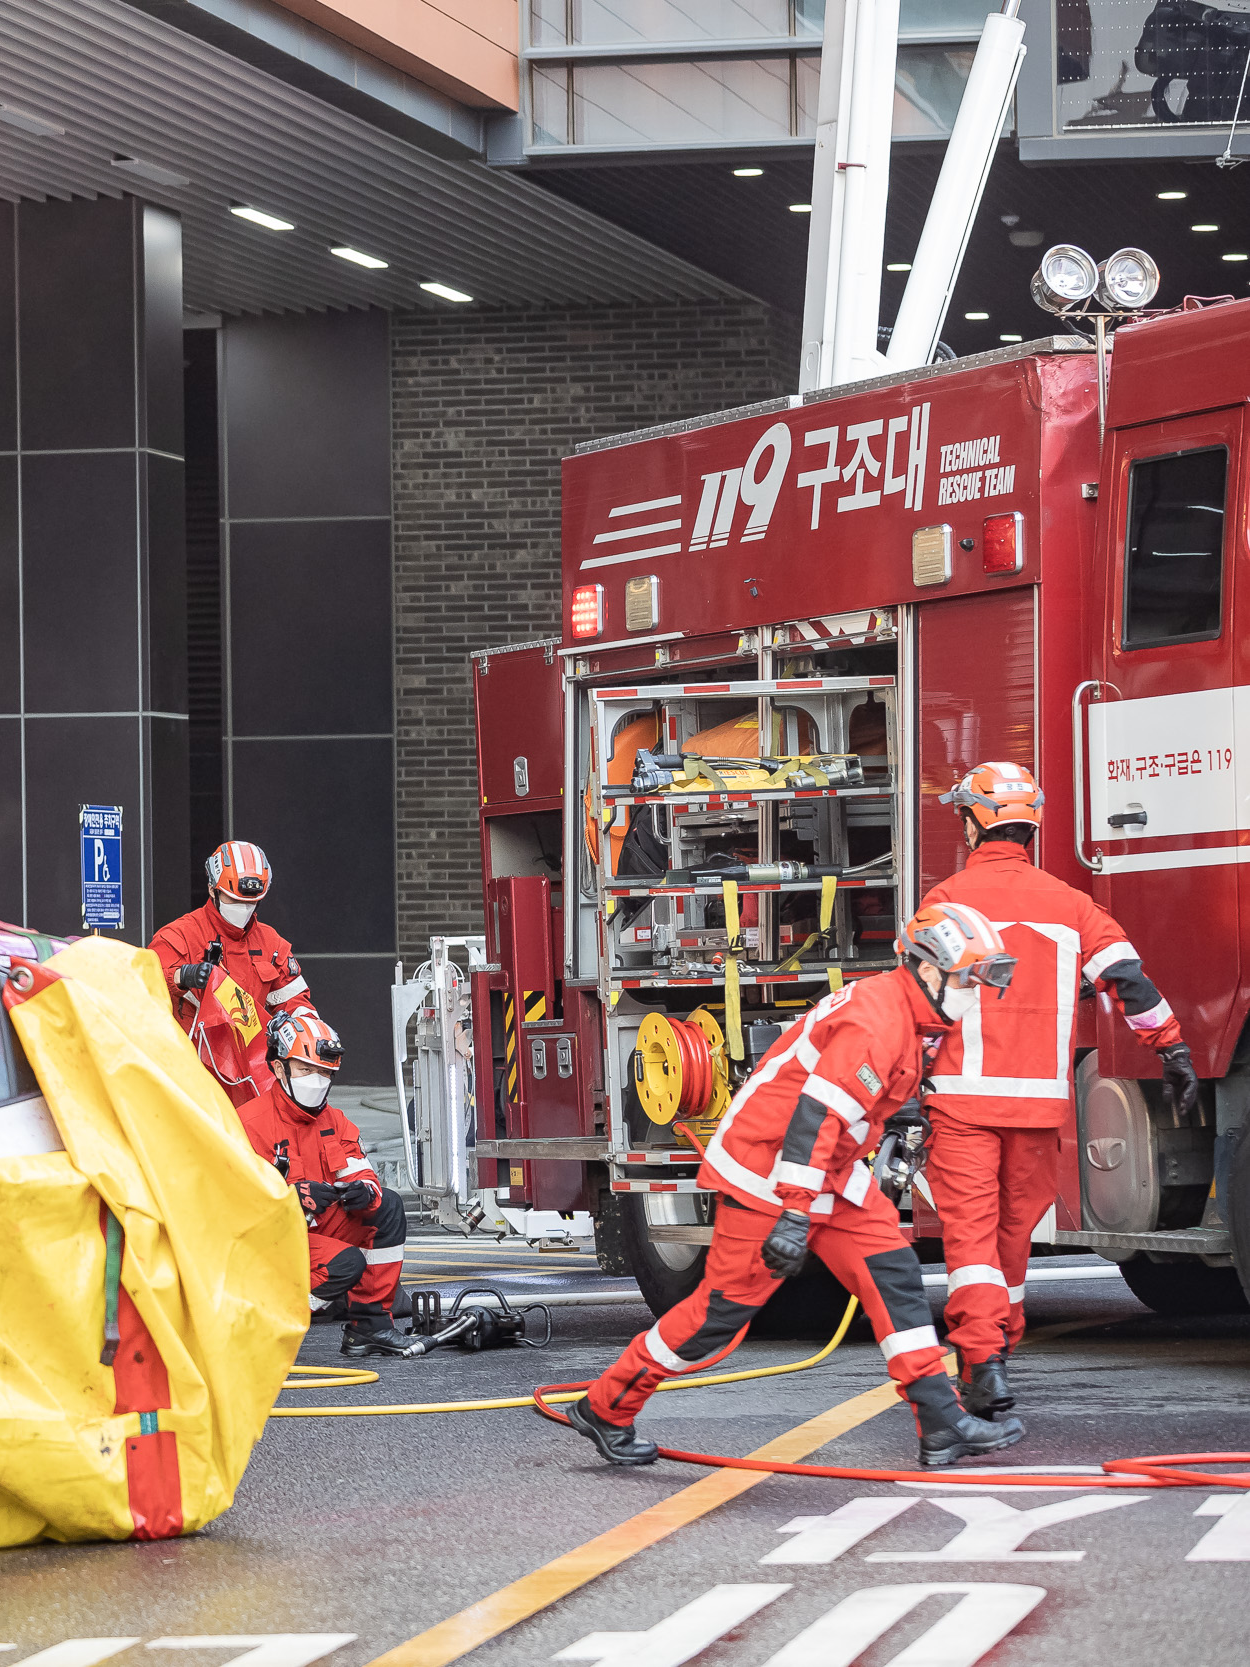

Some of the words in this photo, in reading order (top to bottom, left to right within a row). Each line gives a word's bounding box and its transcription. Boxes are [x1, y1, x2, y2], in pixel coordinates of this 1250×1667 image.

[940, 435, 1000, 473] TECHNICAL
[688, 422, 791, 552] 119
[797, 402, 931, 530] 구조대
[938, 471, 982, 505] RESCUE
[983, 465, 1016, 497] TEAM
[1207, 748, 1232, 771] 119
[94, 839, 104, 881] P
